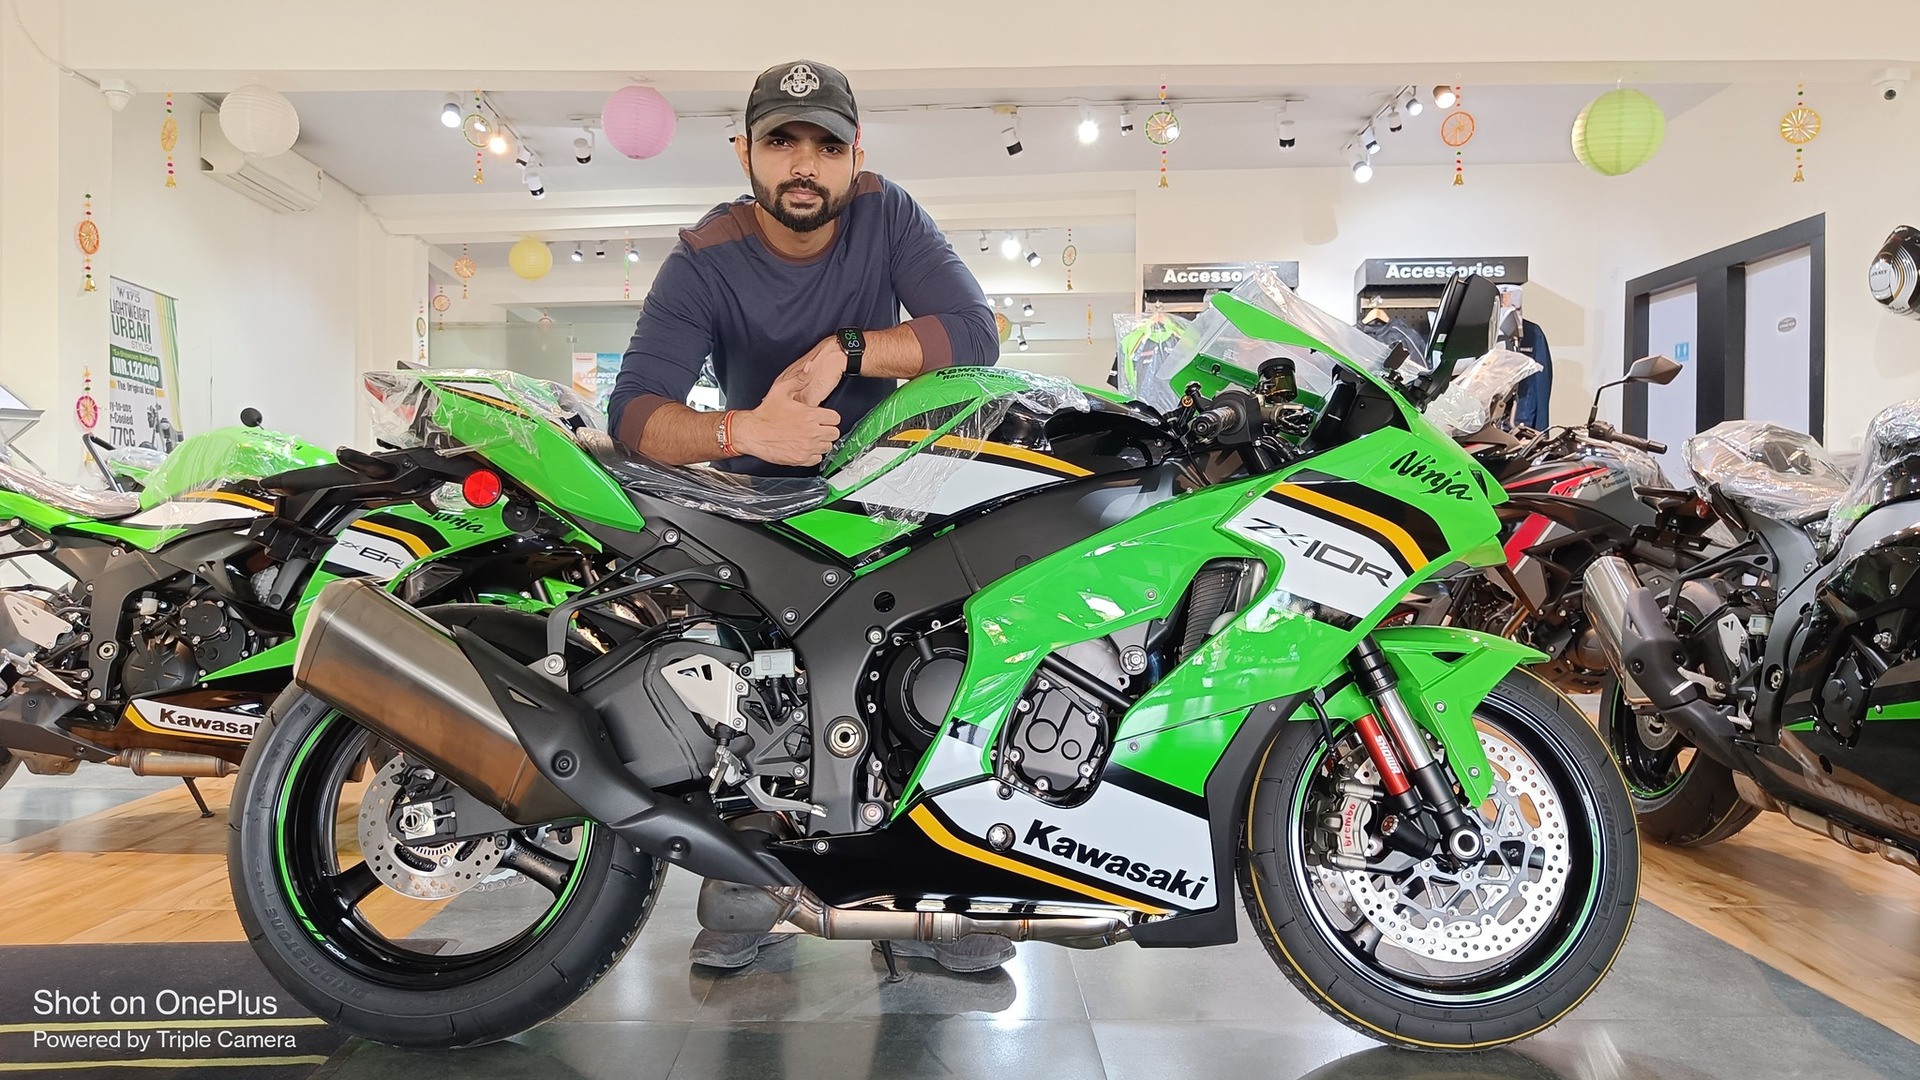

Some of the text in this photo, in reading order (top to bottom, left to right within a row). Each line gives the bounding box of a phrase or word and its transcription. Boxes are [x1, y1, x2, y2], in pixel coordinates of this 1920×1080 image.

[1163, 268, 1278, 284] Accesso
[1385, 262, 1506, 279] Accessories
[111, 313, 152, 345] URBAN
[935, 367, 1011, 378] Kawas
[1389, 450, 1473, 501] Ninja
[1244, 517, 1393, 588] ZX-10R
[1343, 803, 1357, 847] brembo
[1023, 818, 1209, 900] Kawasaki
